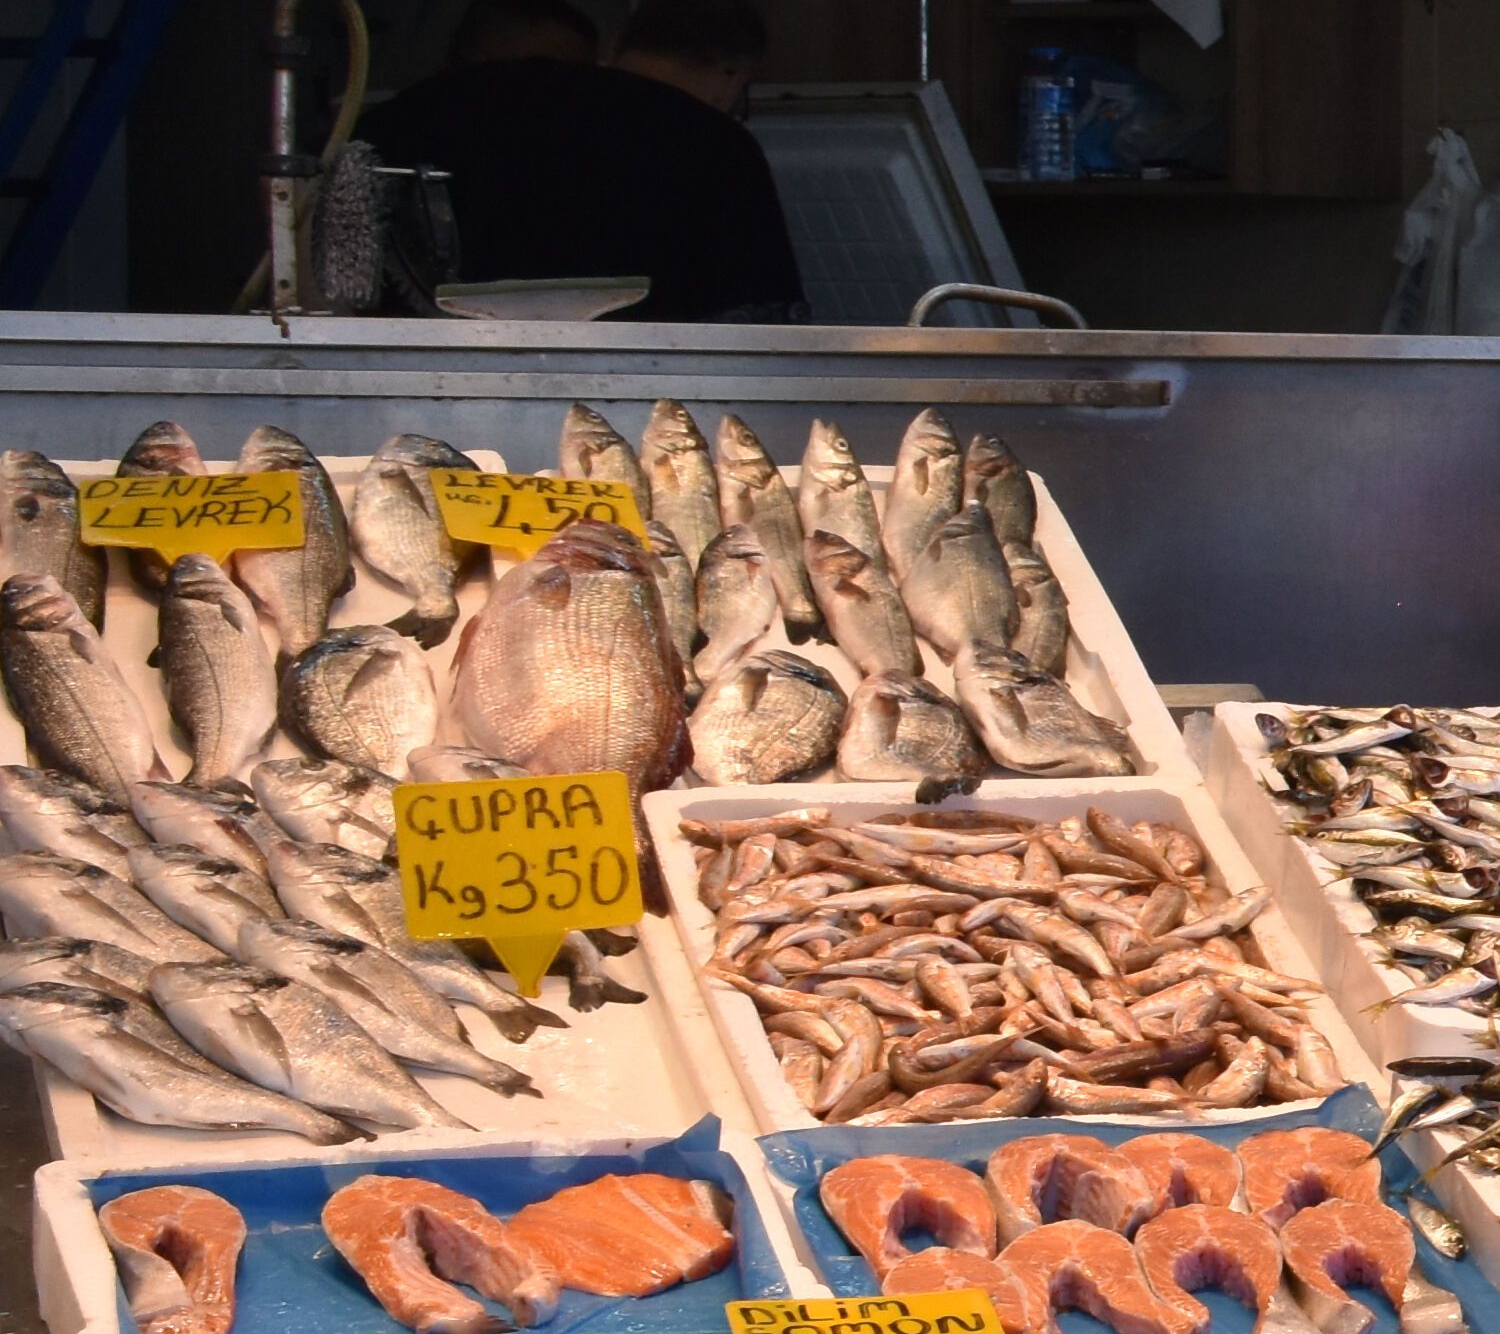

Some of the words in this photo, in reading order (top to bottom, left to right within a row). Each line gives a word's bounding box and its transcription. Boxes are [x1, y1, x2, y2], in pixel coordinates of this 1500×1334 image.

[445, 474, 624, 501] LEVREK
[89, 496, 291, 528] LEVREK
[414, 863, 487, 920] Kg
[497, 844, 629, 914] 350
